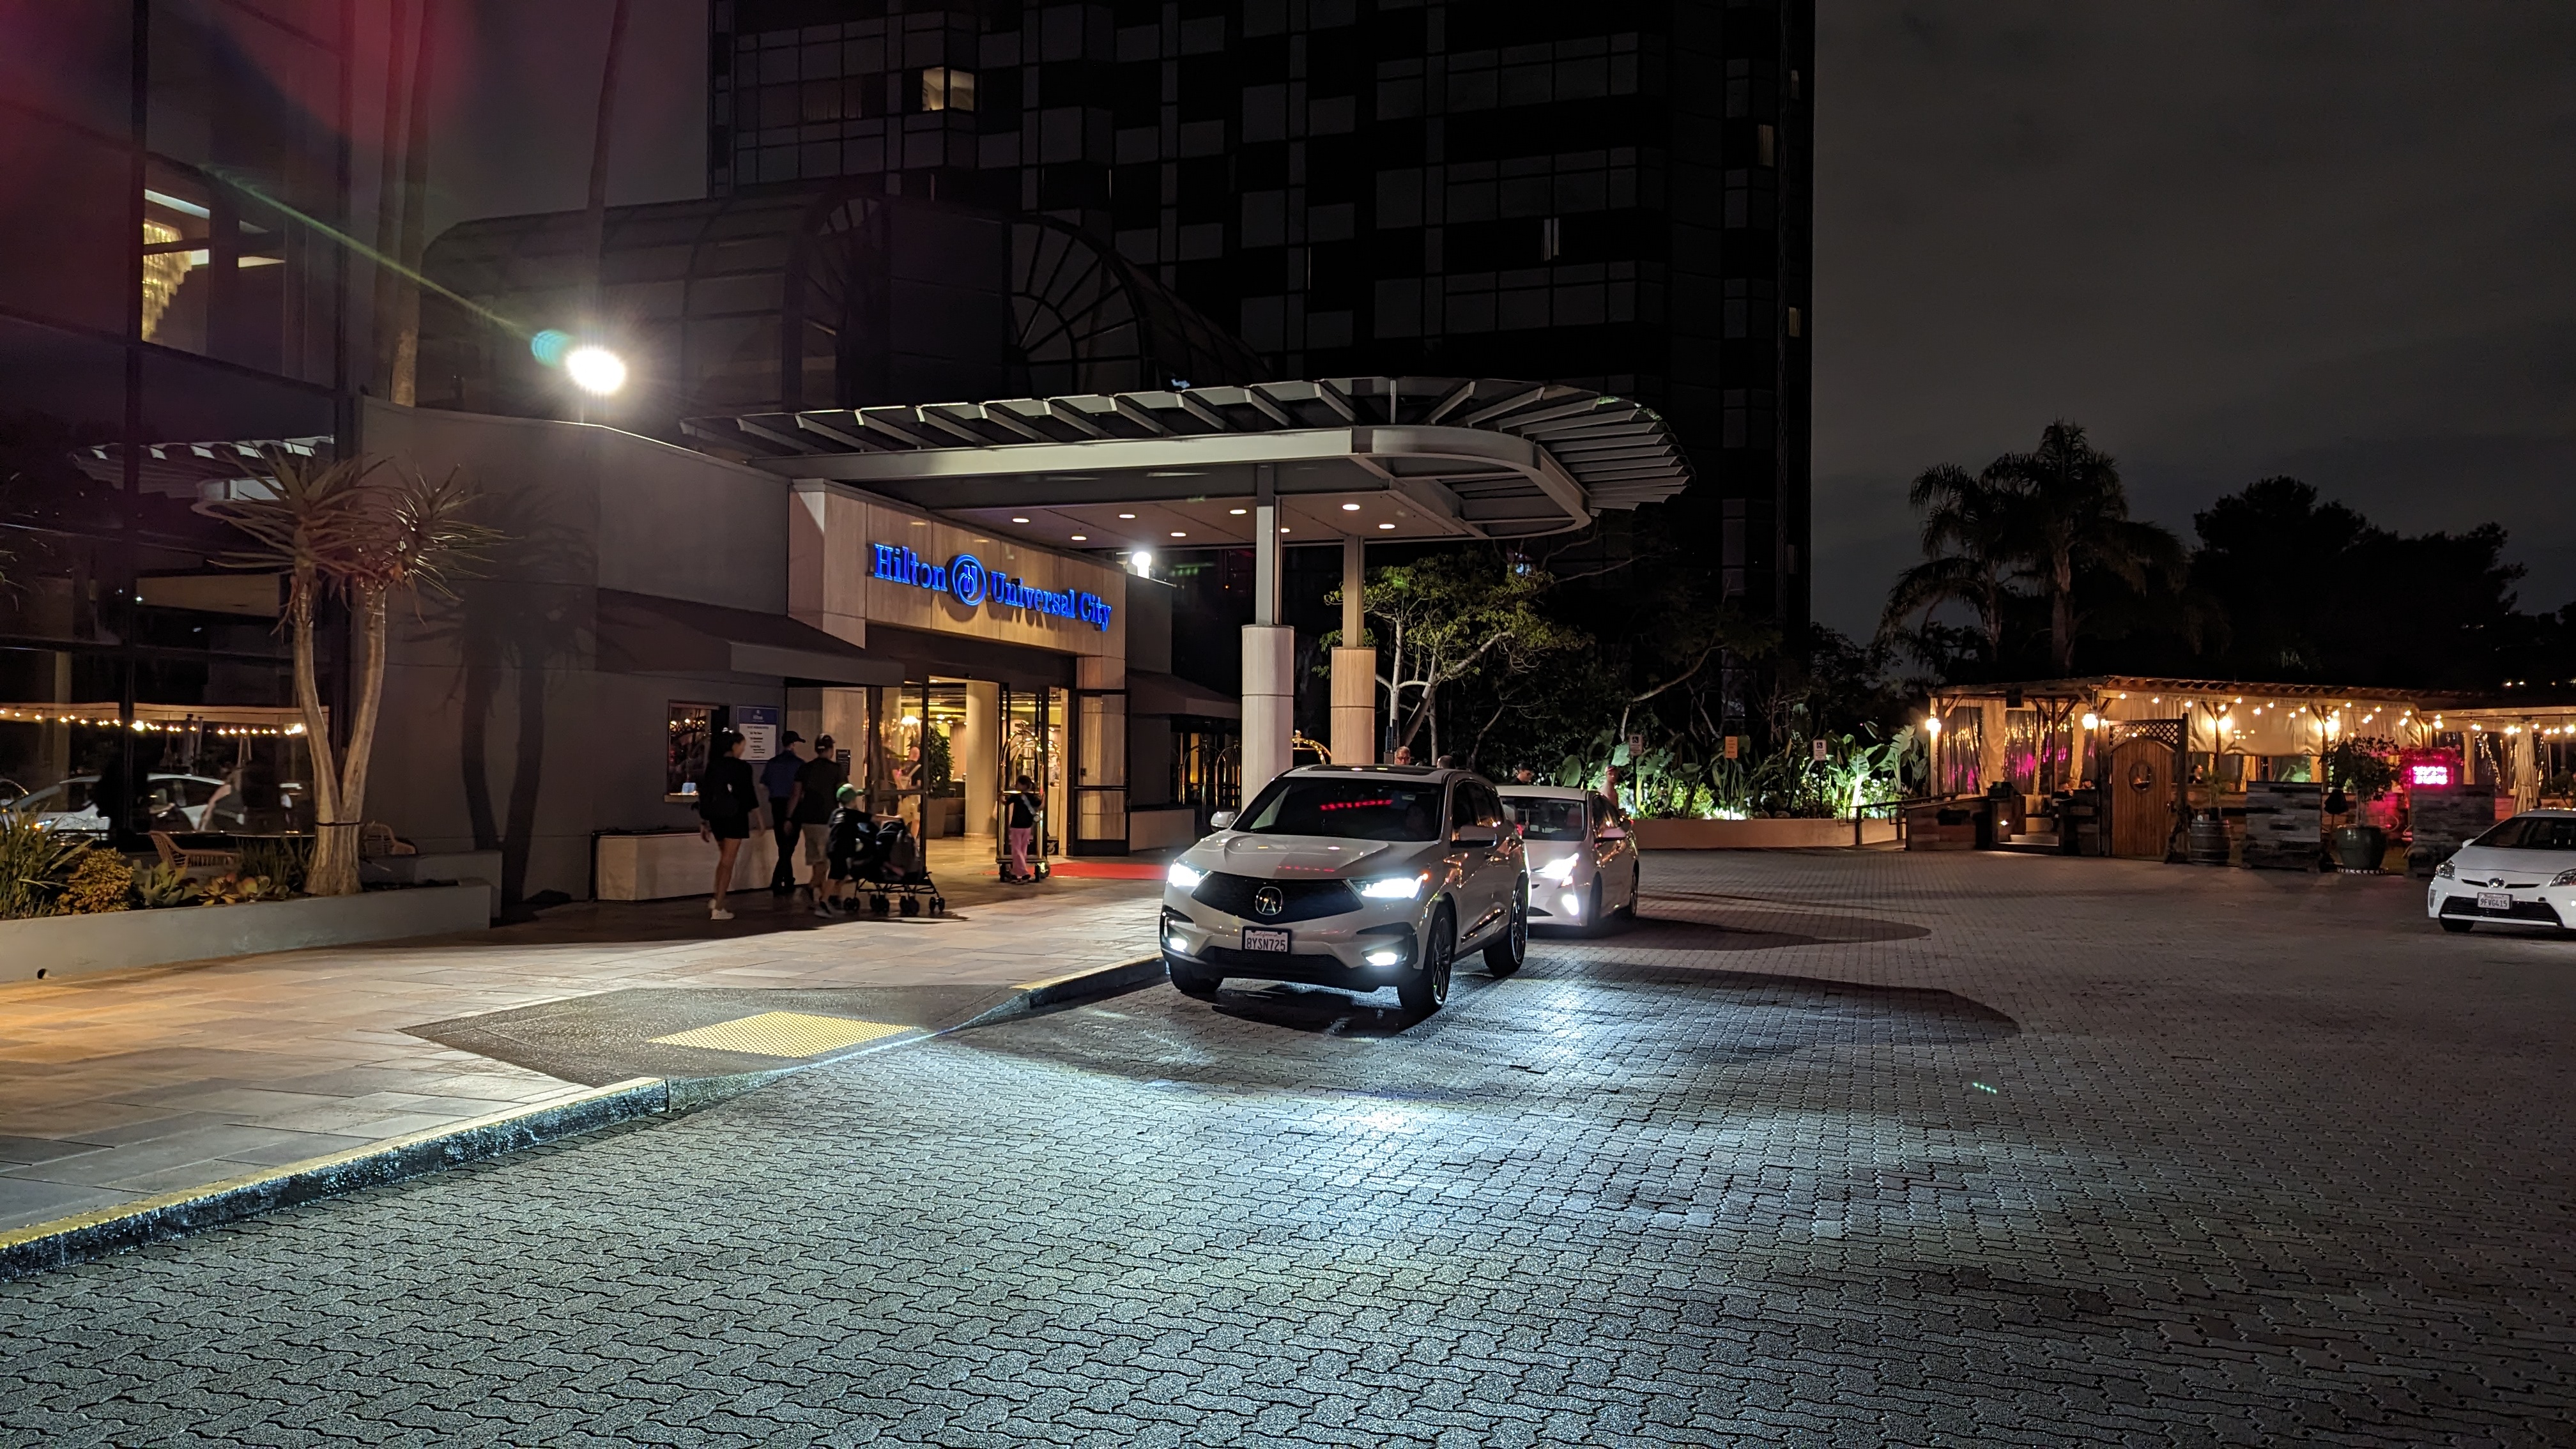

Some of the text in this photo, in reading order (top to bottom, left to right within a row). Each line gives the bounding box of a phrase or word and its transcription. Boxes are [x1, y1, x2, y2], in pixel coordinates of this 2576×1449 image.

[873, 544, 1112, 632] Hilton Universal City
[1246, 937, 1285, 951] 8YSN725
